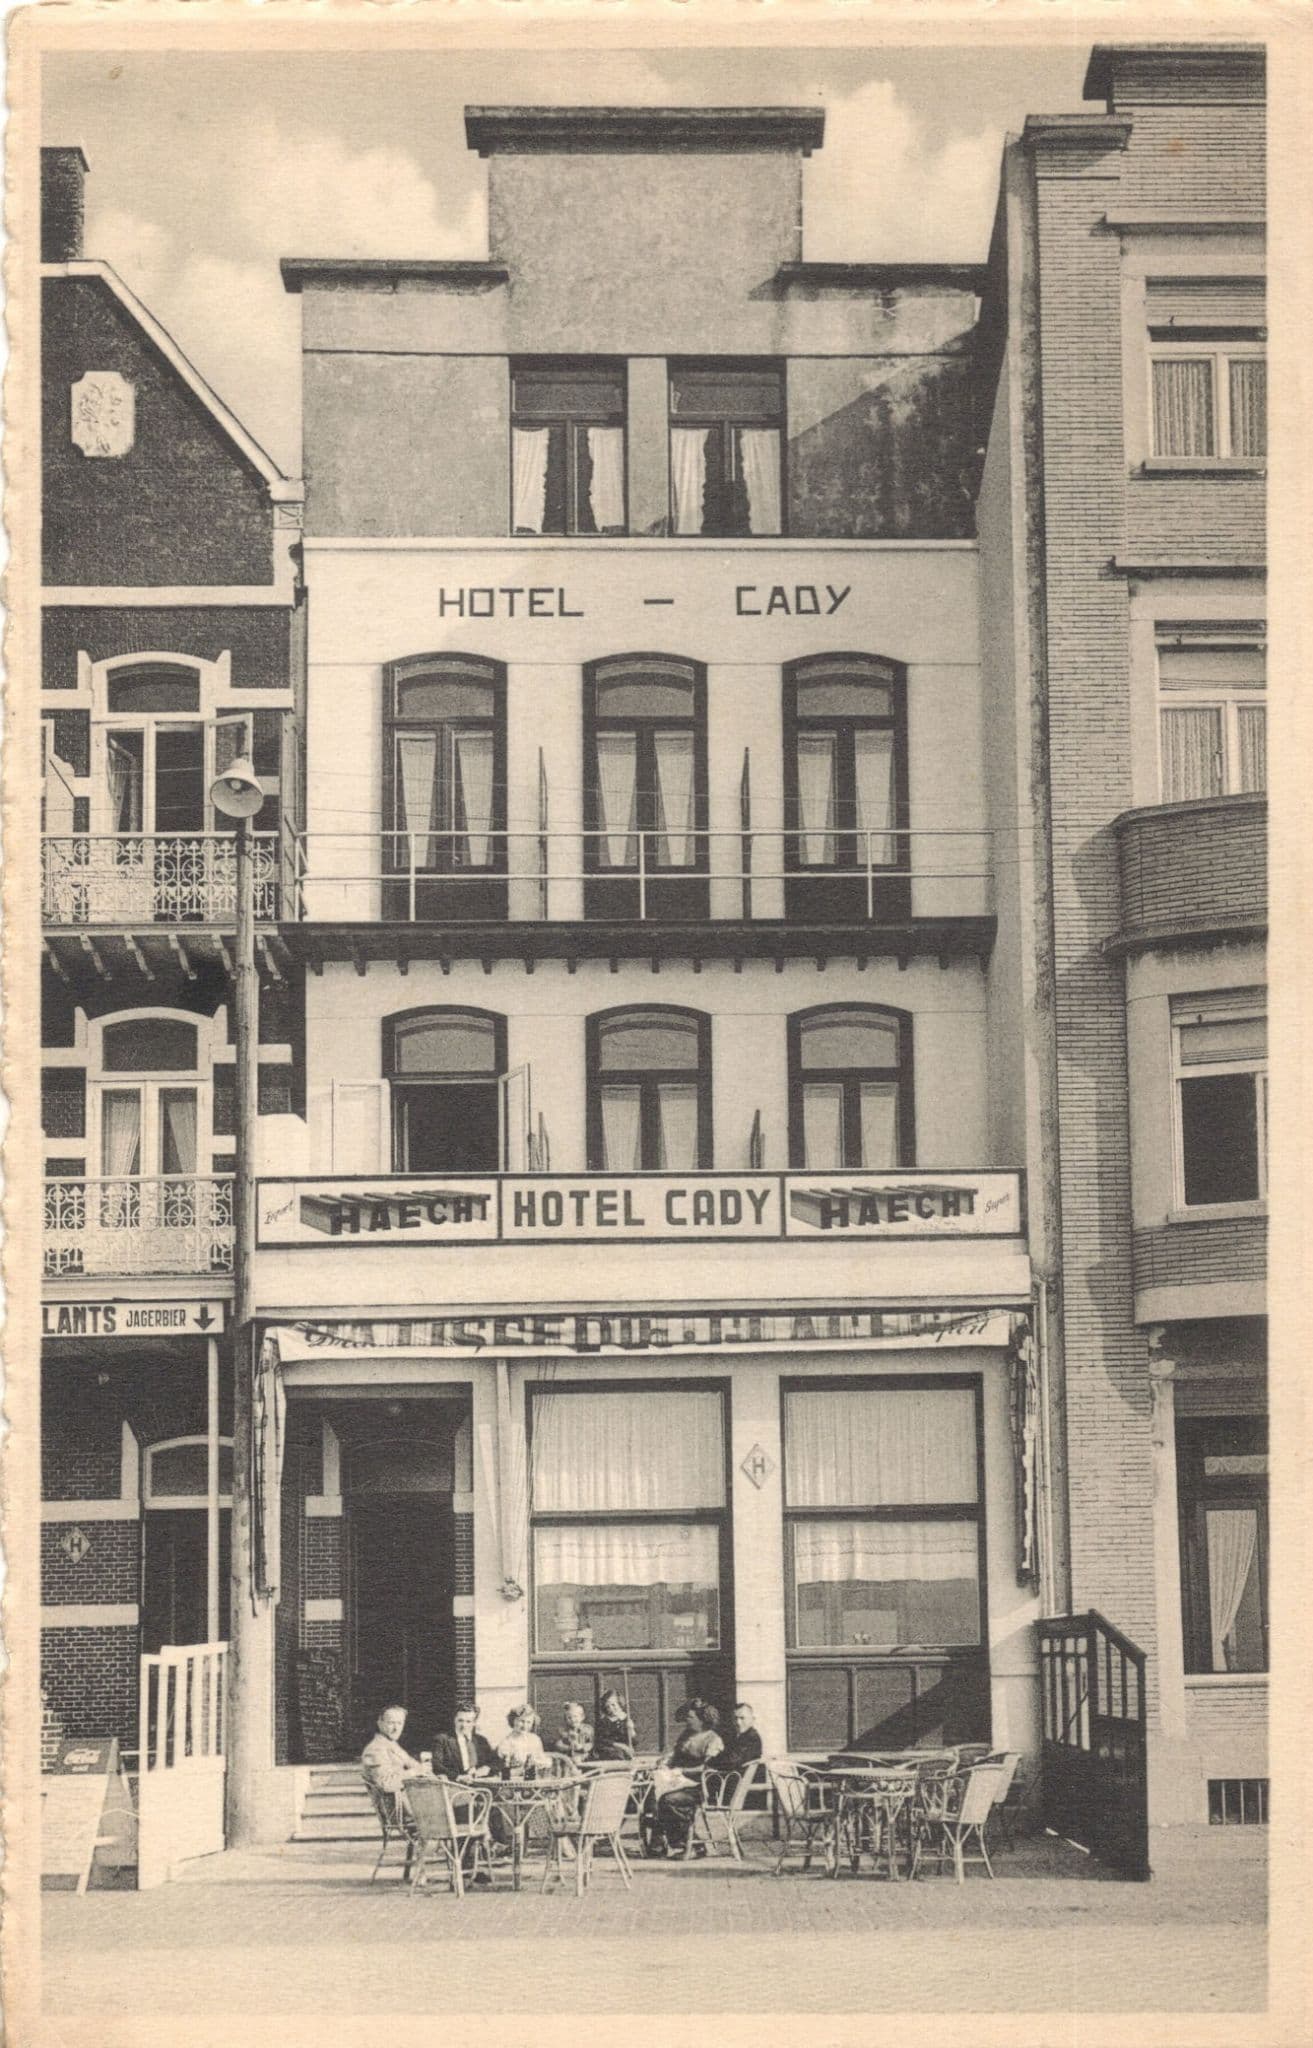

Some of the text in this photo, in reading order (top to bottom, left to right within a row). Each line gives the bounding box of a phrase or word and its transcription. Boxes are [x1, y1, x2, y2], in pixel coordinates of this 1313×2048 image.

[439, 587, 584, 617] HOTEL
[735, 585, 851, 616] CADY
[301, 1190, 491, 1236] HAECHT
[513, 1188, 771, 1227] HOTEL CADY
[790, 1184, 978, 1230] HAECHT
[42, 1305, 186, 1334] LANTS JAGERBIER
